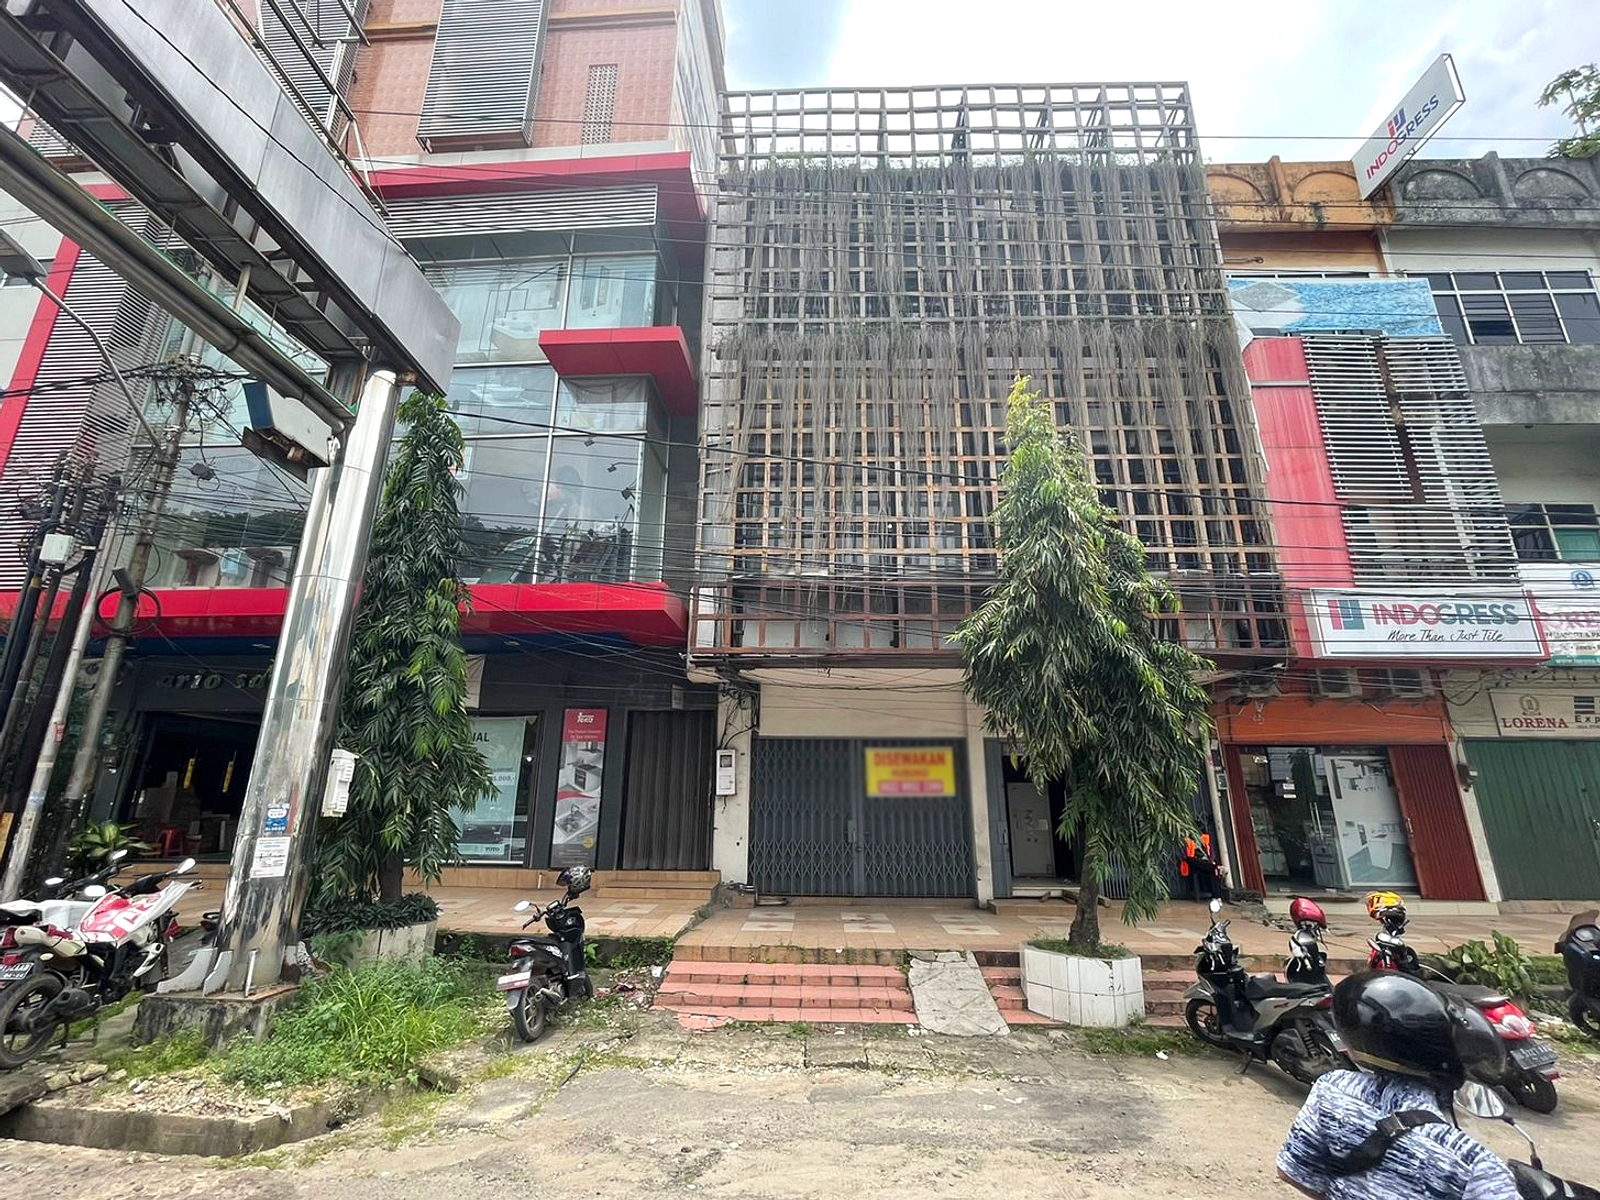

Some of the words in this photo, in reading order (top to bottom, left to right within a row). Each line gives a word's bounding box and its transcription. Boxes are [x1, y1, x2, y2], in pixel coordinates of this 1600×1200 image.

[1366, 95, 1439, 179] INDOGRESS
[1372, 603, 1519, 625] INDOGRESS
[1387, 629, 1416, 642] More
[1419, 629, 1444, 642] Than
[1450, 629, 1478, 642] Just
[1482, 630, 1504, 642] Tile
[1501, 717, 1569, 729] LORENA
